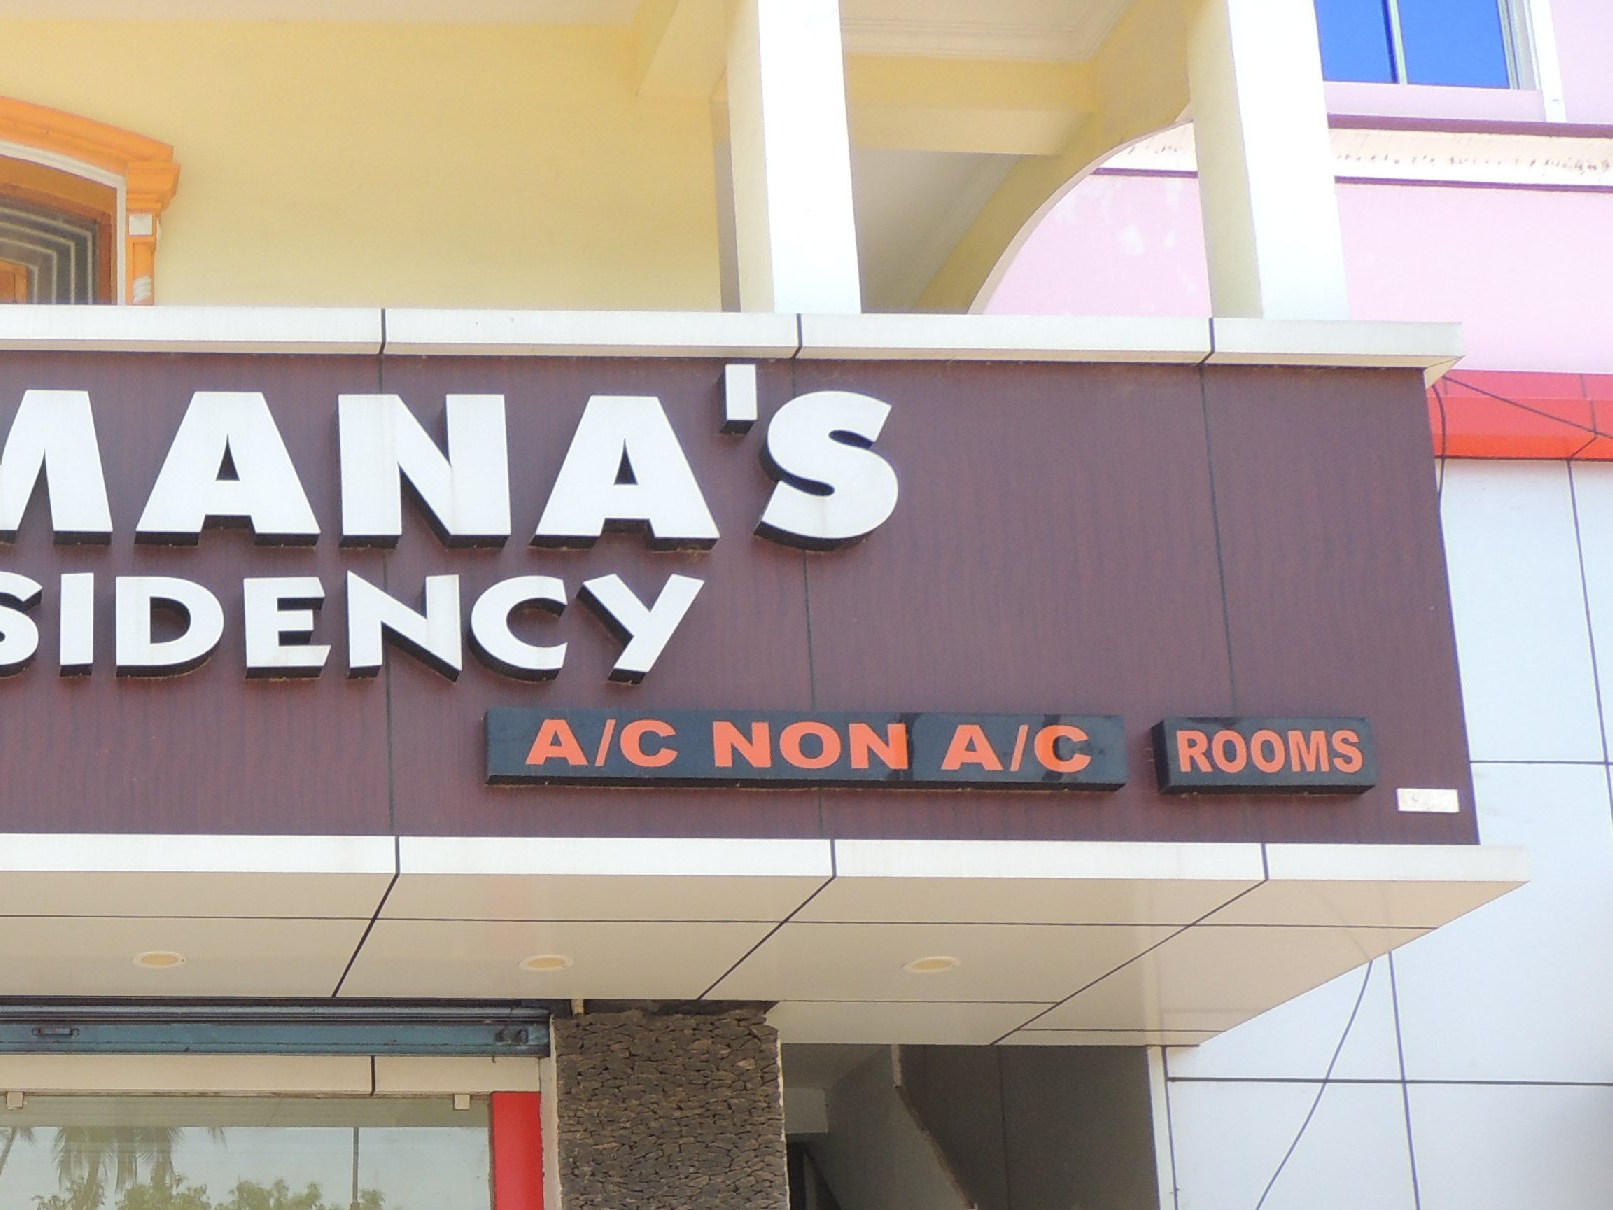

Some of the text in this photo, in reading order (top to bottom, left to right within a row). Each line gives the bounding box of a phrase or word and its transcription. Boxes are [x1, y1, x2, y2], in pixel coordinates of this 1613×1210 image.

[526, 718, 1365, 775] A/C NON A/C ROOMS
